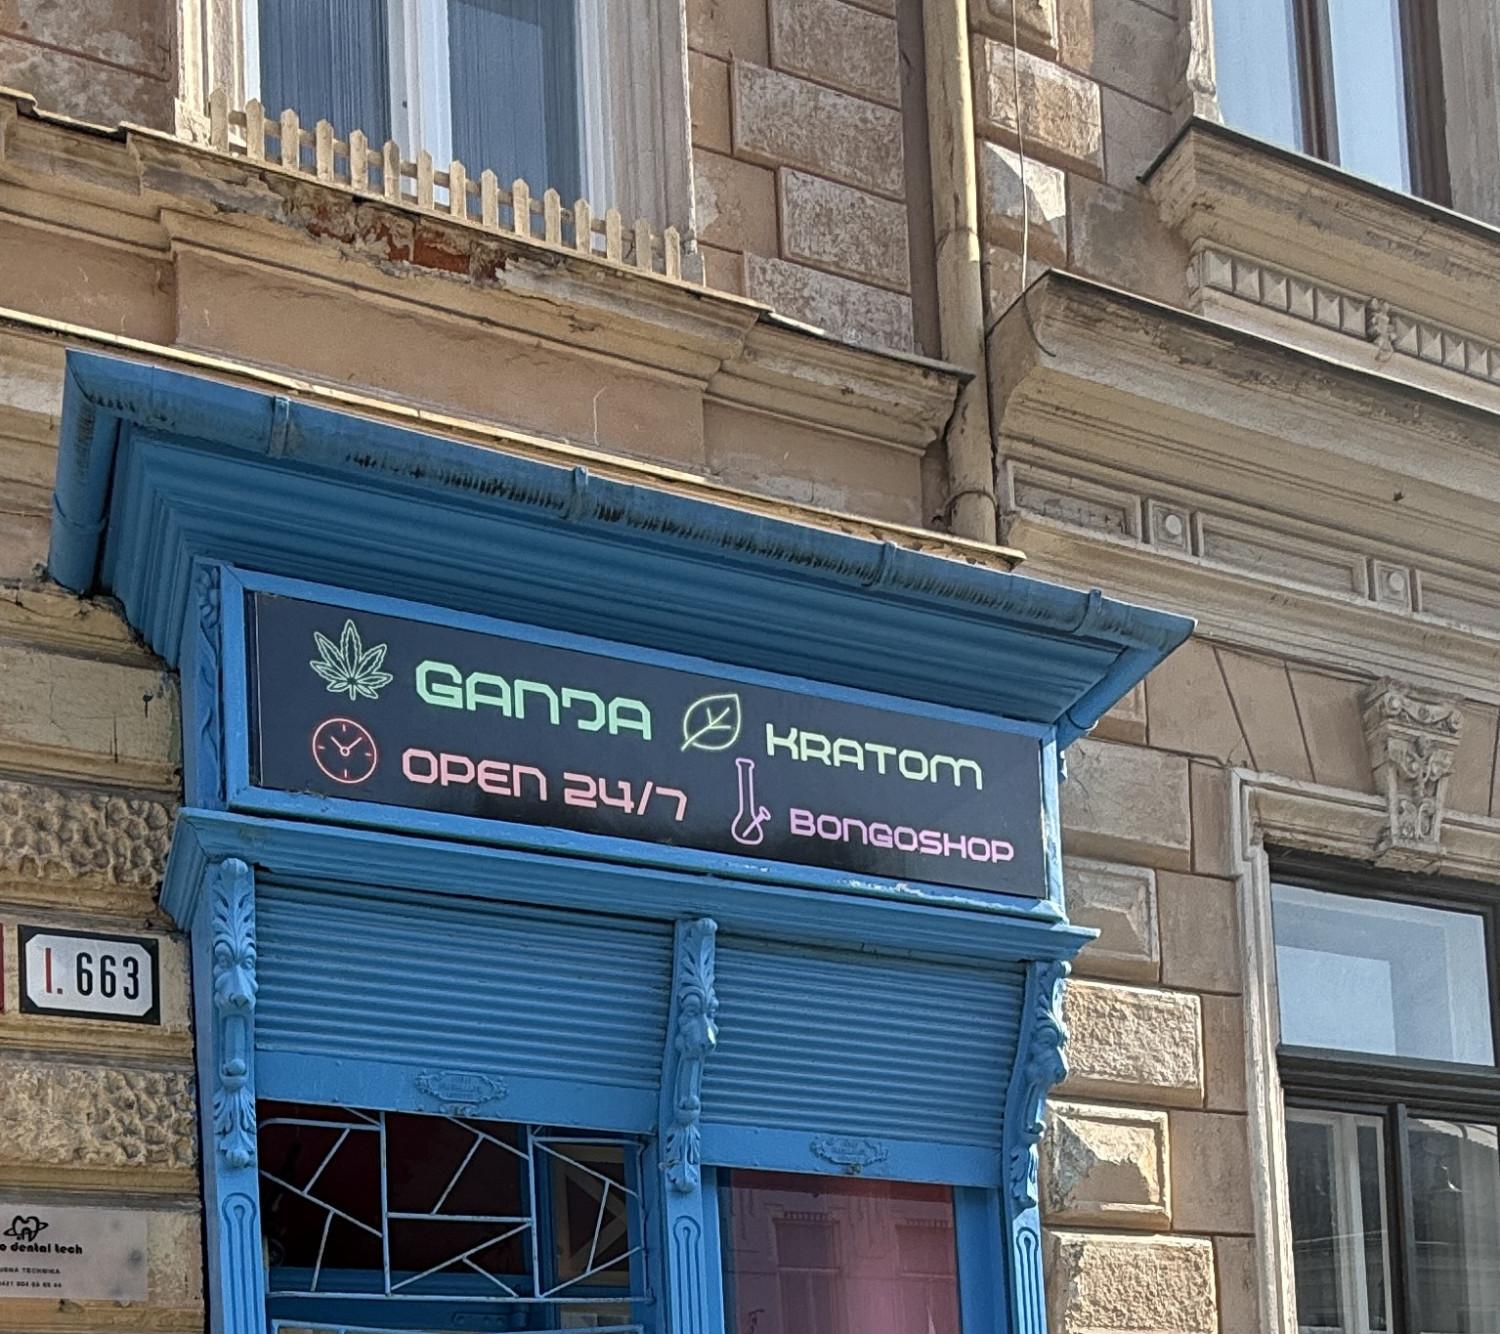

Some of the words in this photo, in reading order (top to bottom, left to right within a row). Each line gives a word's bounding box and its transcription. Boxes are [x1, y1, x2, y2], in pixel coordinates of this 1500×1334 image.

[402, 747, 548, 802] OPEN
[562, 771, 688, 822] 24/7
[765, 722, 983, 791] KRATOM
[789, 807, 1015, 863] BONGOSHOP
[76, 951, 140, 1001] 663
[10, 1242, 51, 1254] dental
[54, 1243, 83, 1255] tech
